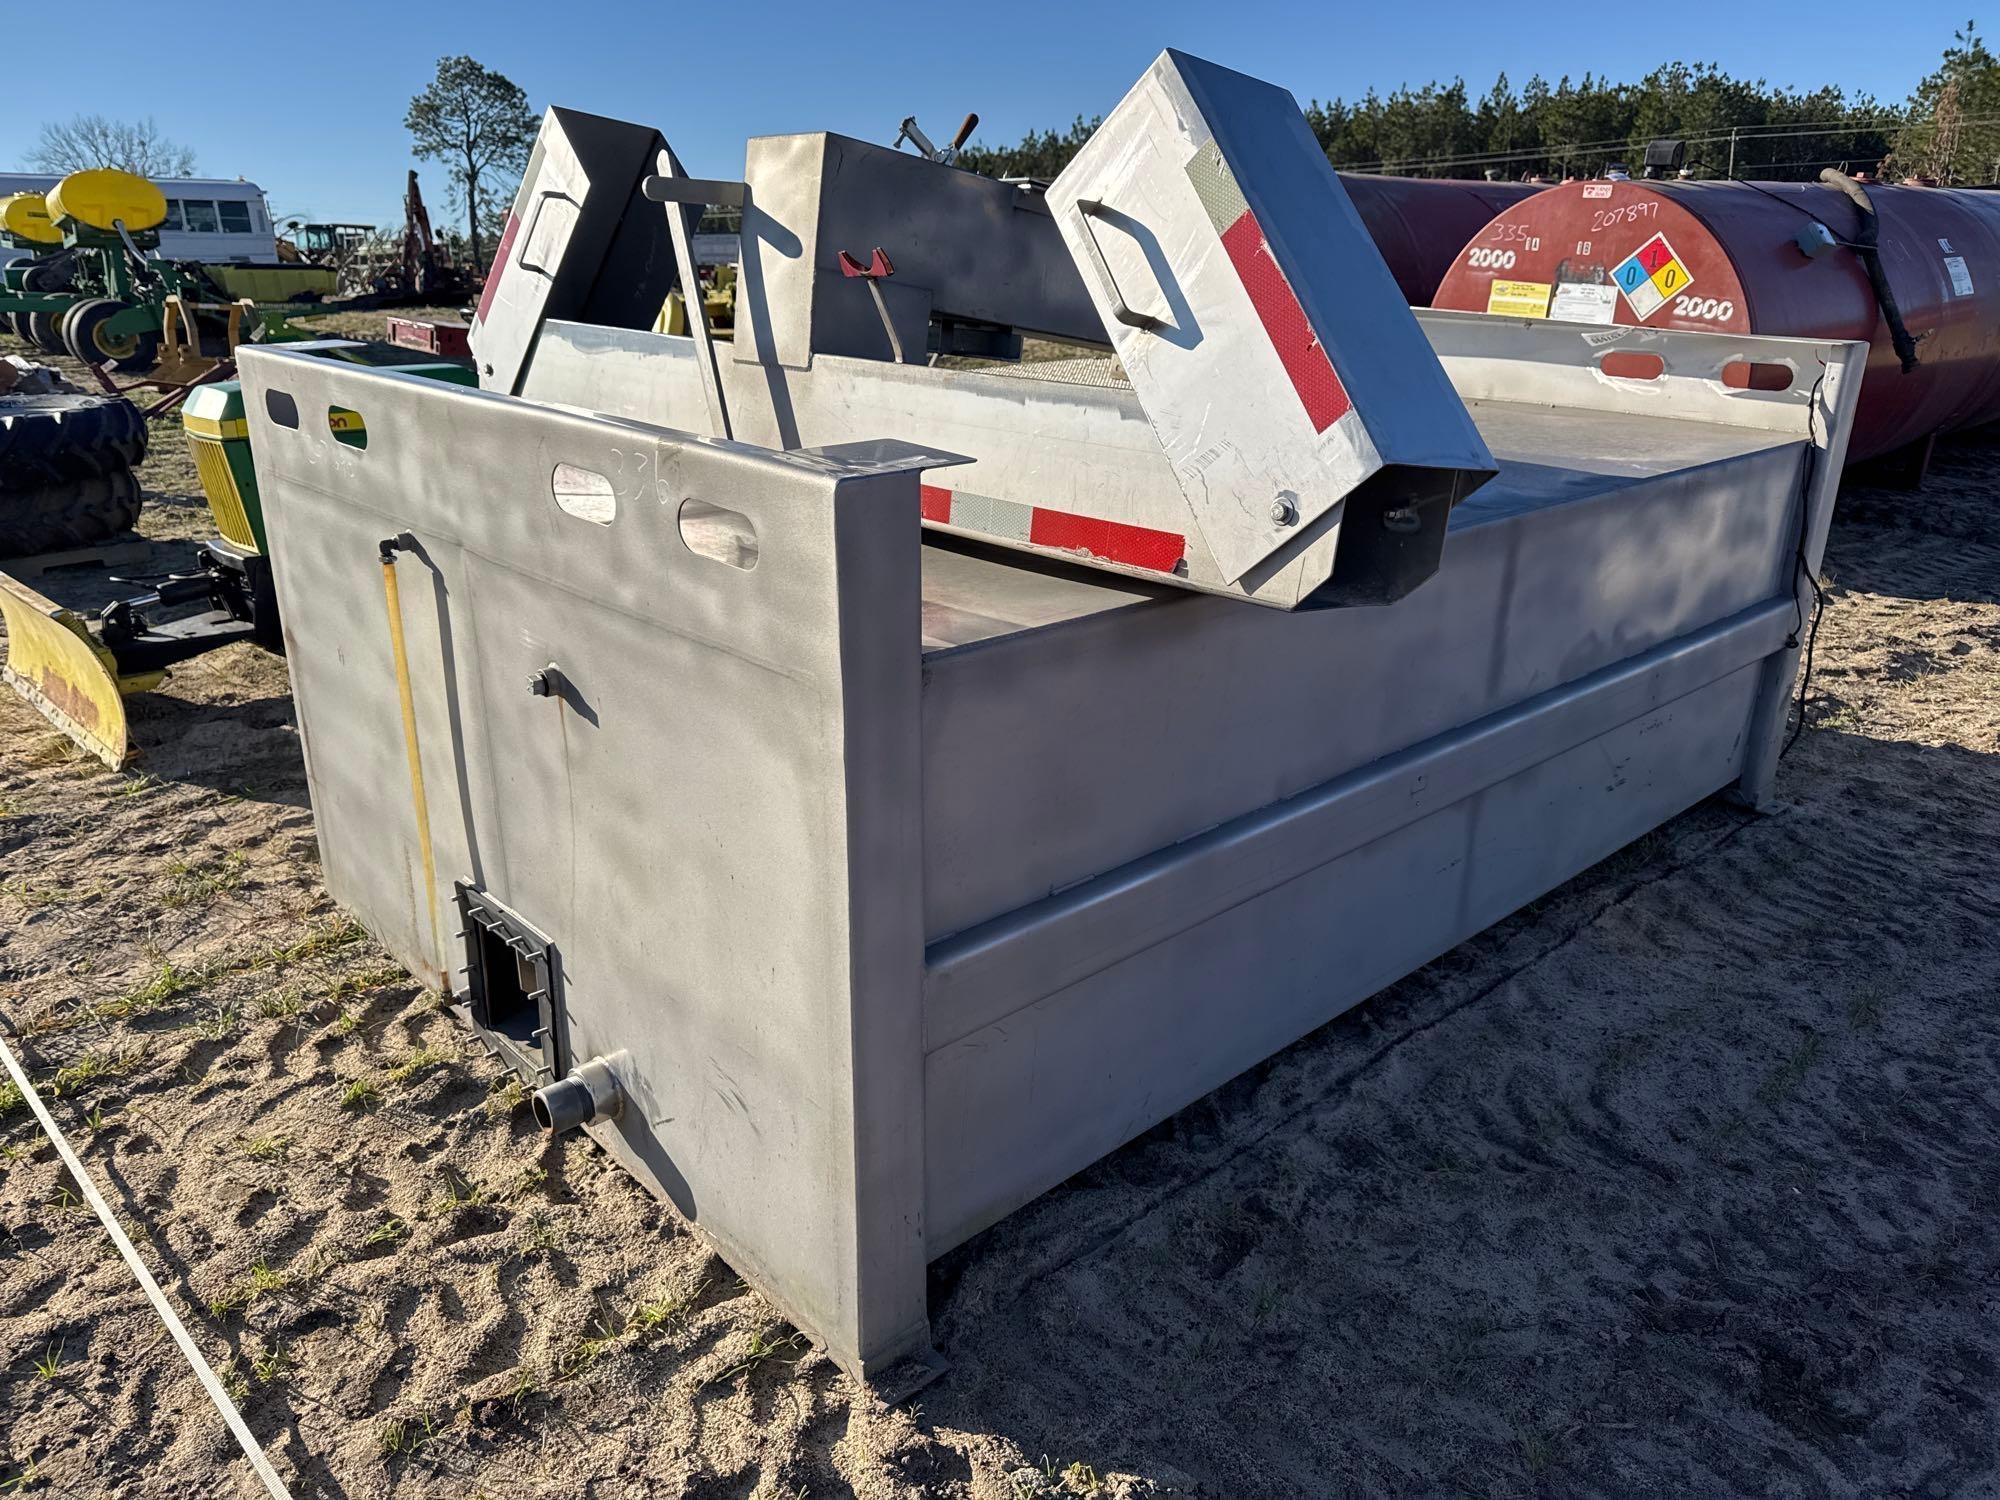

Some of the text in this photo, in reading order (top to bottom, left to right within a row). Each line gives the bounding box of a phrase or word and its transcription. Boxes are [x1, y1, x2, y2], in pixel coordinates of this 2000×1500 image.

[1591, 202, 1659, 232] 207897
[1491, 223, 1529, 242] 335
[1468, 247, 1516, 269] 2000
[1650, 250, 1658, 268] 1
[1626, 266, 1637, 286] 0
[1665, 269, 1676, 288] 0
[1673, 295, 1733, 321] 2000
